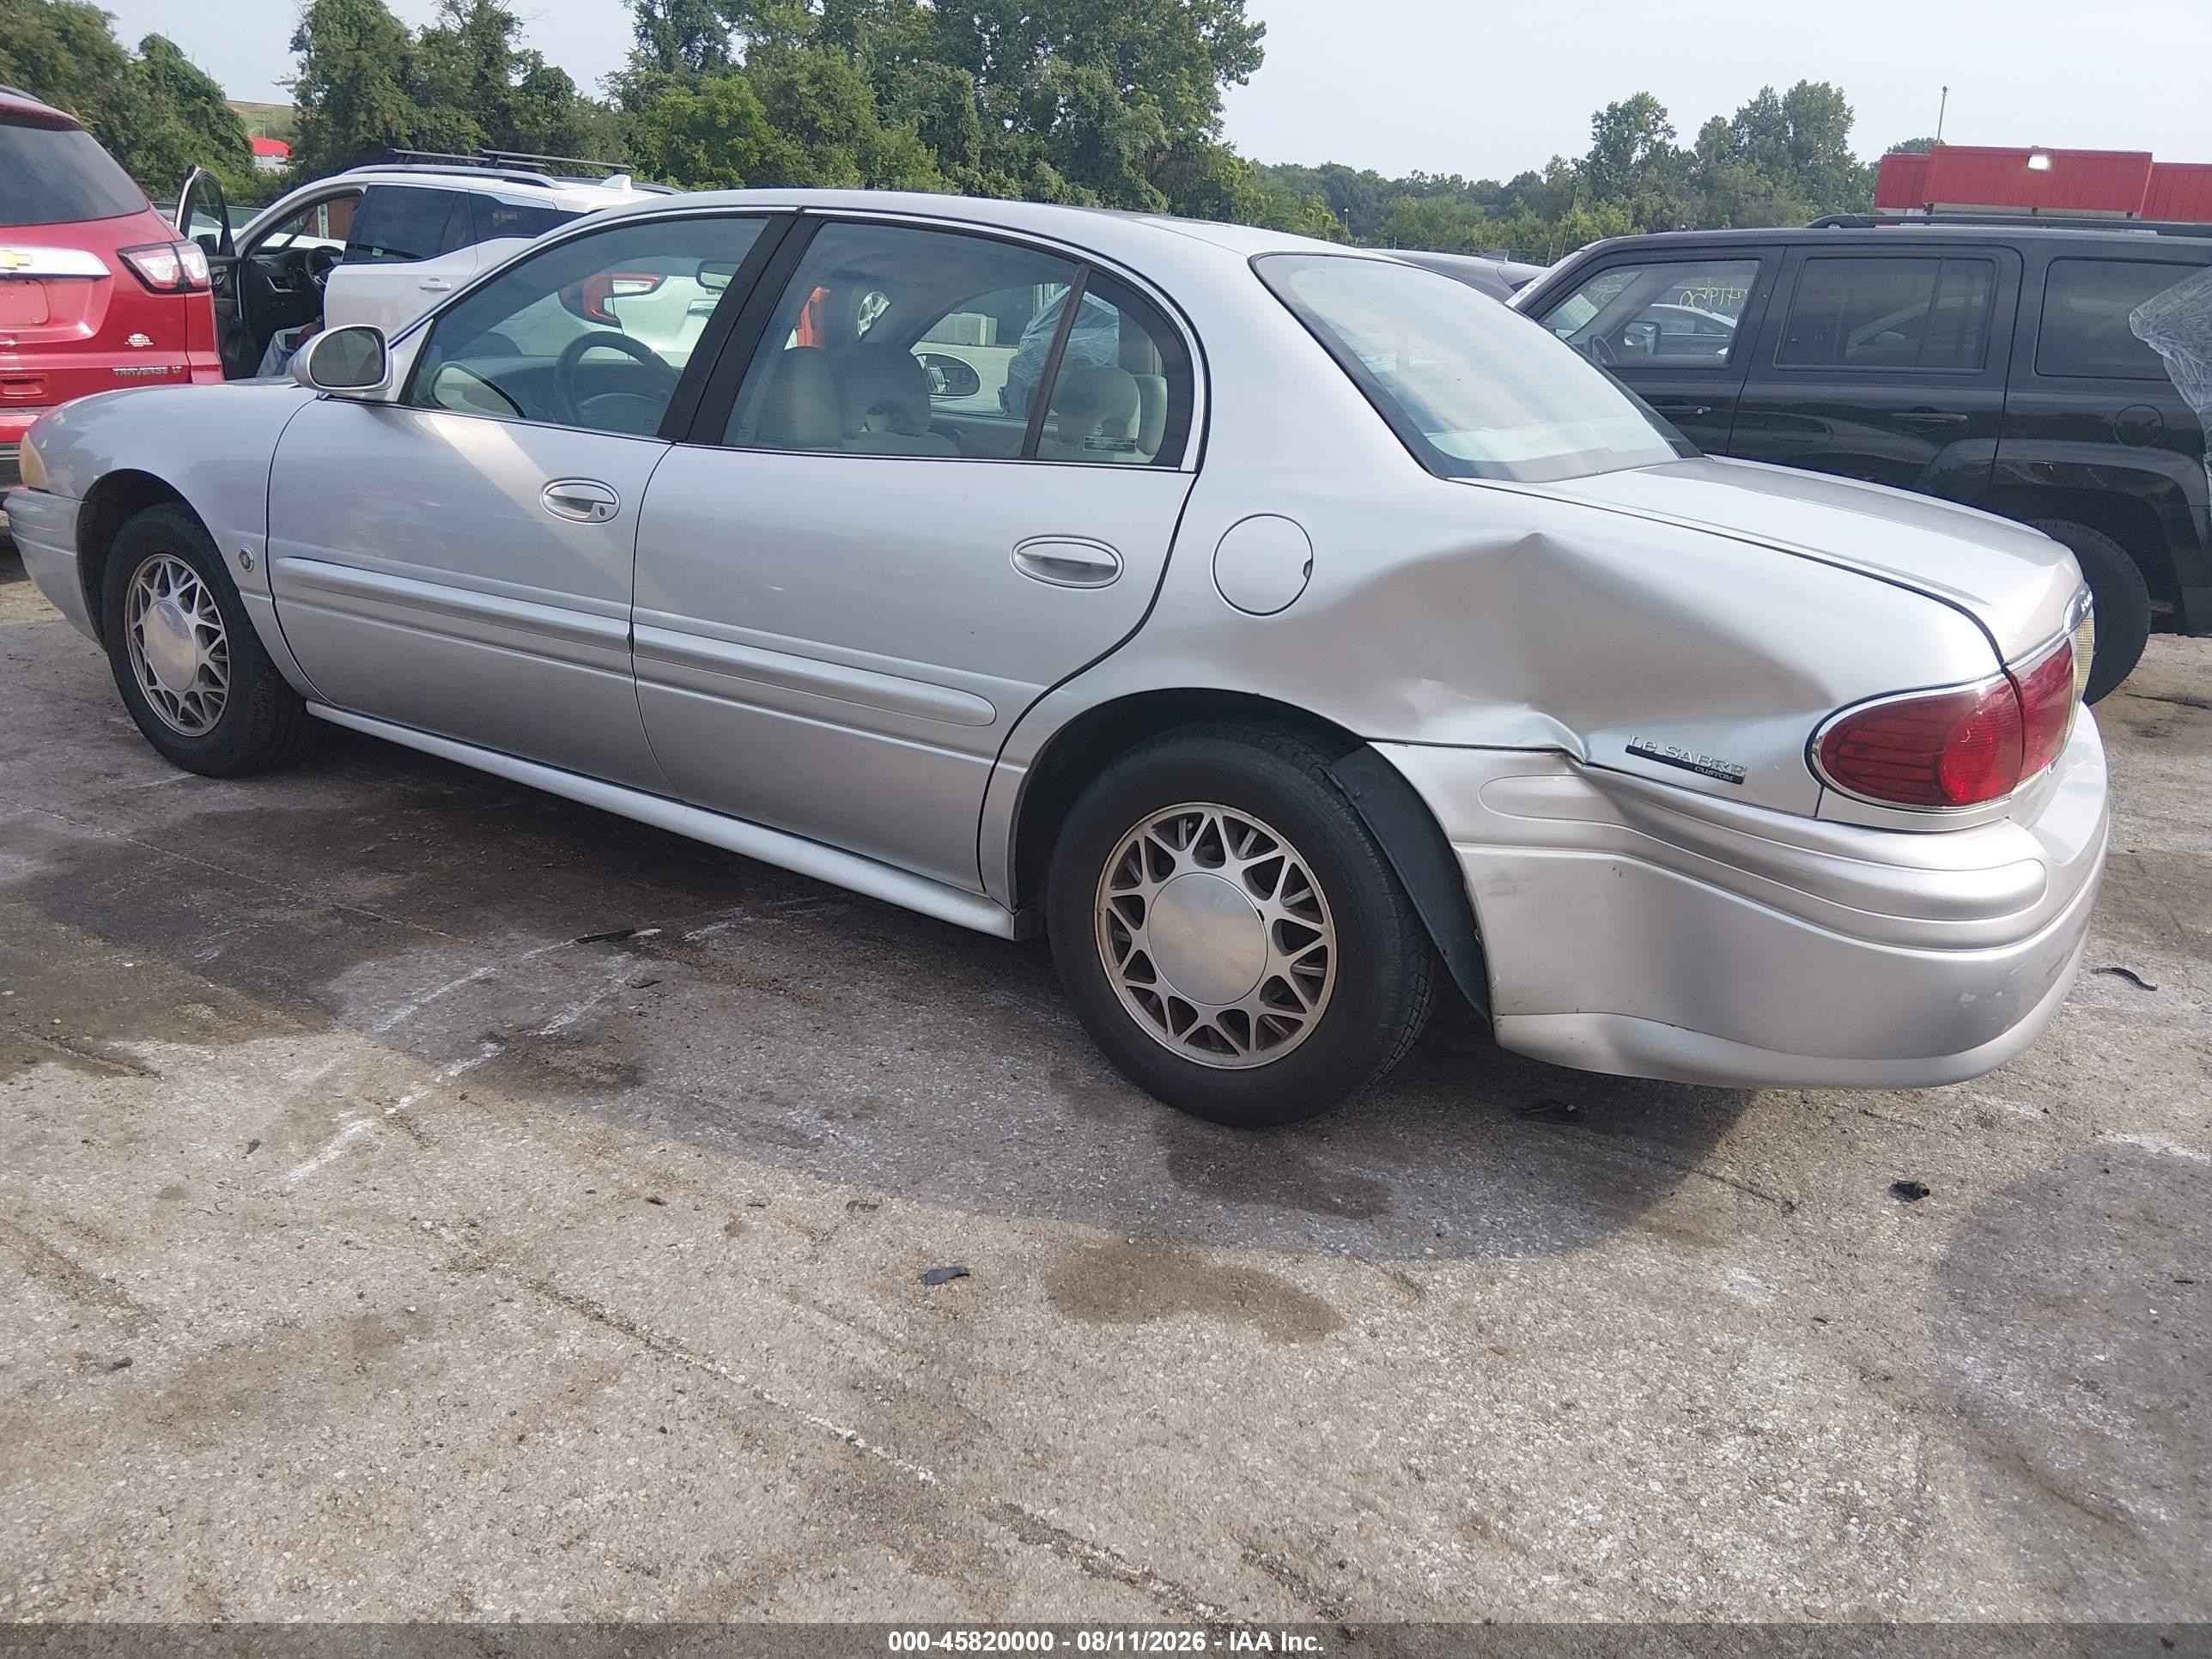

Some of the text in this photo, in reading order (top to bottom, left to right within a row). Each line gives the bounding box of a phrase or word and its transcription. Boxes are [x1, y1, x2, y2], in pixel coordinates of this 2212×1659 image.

[112, 366, 168, 376] TRAVERSE
[1662, 743, 1747, 777] SABRE
[1694, 766, 1735, 782] CUSTOM
